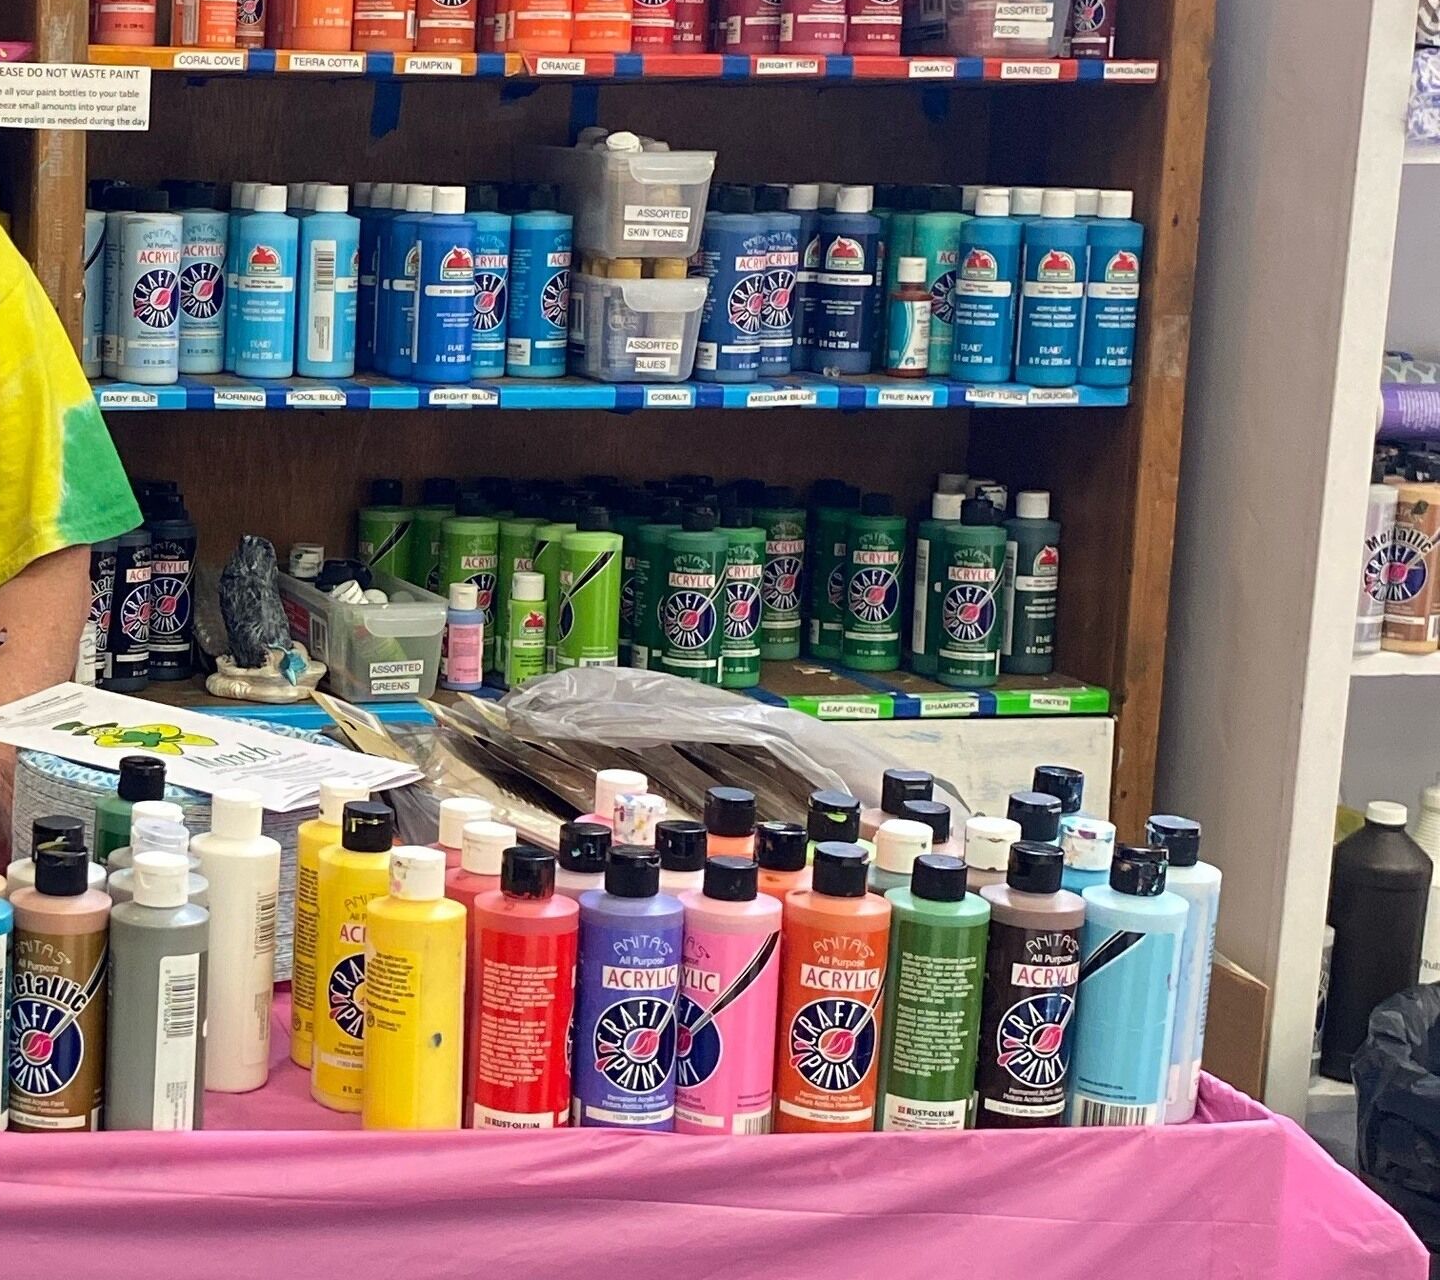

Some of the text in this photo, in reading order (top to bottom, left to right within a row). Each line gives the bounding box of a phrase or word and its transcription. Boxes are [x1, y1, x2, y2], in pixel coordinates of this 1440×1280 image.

[997, 5, 1048, 16] ASSORTED
[179, 55, 241, 66] CORAL COVE
[293, 56, 359, 68] TERRA COTTA
[410, 60, 452, 71] PUMPKIN
[541, 61, 581, 72] ORANGE
[759, 60, 815, 71] BRIGHT RED
[27, 68, 42, 77] DO
[46, 68, 68, 78] NOT
[71, 69, 106, 79] WASTE
[110, 70, 140, 80] PAINT
[914, 64, 952, 73] TOMATO
[1006, 66, 1052, 75] BARN RED
[4, 88, 14, 96] all
[36, 89, 57, 98] paint
[59, 89, 86, 97] bottles
[99, 91, 117, 99] your
[119, 90, 140, 98] table
[19, 102, 40, 110] small
[42, 103, 76, 111] amounts
[78, 103, 94, 111] into
[96, 105, 114, 113] your
[116, 103, 136, 112] plate
[1, 116, 22, 124] more
[24, 116, 45, 125] paint
[58, 116, 87, 125] needed
[89, 117, 115, 126] during
[117, 118, 130, 126] the
[132, 118, 147, 127] day
[637, 209, 688, 219] ASSORTED
[628, 228, 684, 238] SKIN TONES
[140, 251, 179, 263] ACRYLIC
[183, 245, 223, 257] ACRYLIC
[628, 341, 679, 350] ASSORTED
[103, 394, 128, 402] BABY
[217, 392, 263, 402] MORNING
[290, 393, 317, 401] POOL
[433, 393, 468, 401] BRIGHT
[651, 393, 688, 402] COBALT
[750, 394, 787, 402] MEDIUM
[881, 393, 905, 401] TRUE
[855, 552, 898, 564] ACRYLIC
[950, 568, 995, 580] ACRYLIC
[671, 575, 714, 588] ACRYLIC
[767, 592, 799, 608] PAINT
[856, 604, 890, 622] PAINT
[950, 621, 984, 639] PAINT
[669, 628, 706, 647] PAINT
[371, 663, 421, 673] ASSORTED
[371, 682, 410, 691] GREENS
[925, 701, 975, 710] SHAMROCK
[1033, 698, 1069, 707] HUNTER
[821, 706, 877, 715] LEAF GREEN
[613, 934, 673, 955] ANITA'S
[814, 936, 875, 958] ANITA'S
[1026, 933, 1079, 954] ANITA'S
[619, 956, 665, 968] All Purpose
[818, 956, 865, 968] All Purpose
[1031, 954, 1072, 965] All Purpose
[331, 959, 364, 998] CRA
[607, 967, 675, 989] ACRYLIC
[684, 969, 717, 992] YLIC
[805, 967, 878, 989] ACRYLIC
[1017, 967, 1077, 986] ACRYLIC
[13, 973, 86, 1012] etallic
[598, 1001, 663, 1047] CRAFT
[794, 1001, 864, 1047] CRAFT
[610, 1056, 665, 1090] PAINT
[805, 1054, 863, 1089] PAINT
[906, 1106, 955, 1118] RUST-OLEUM
